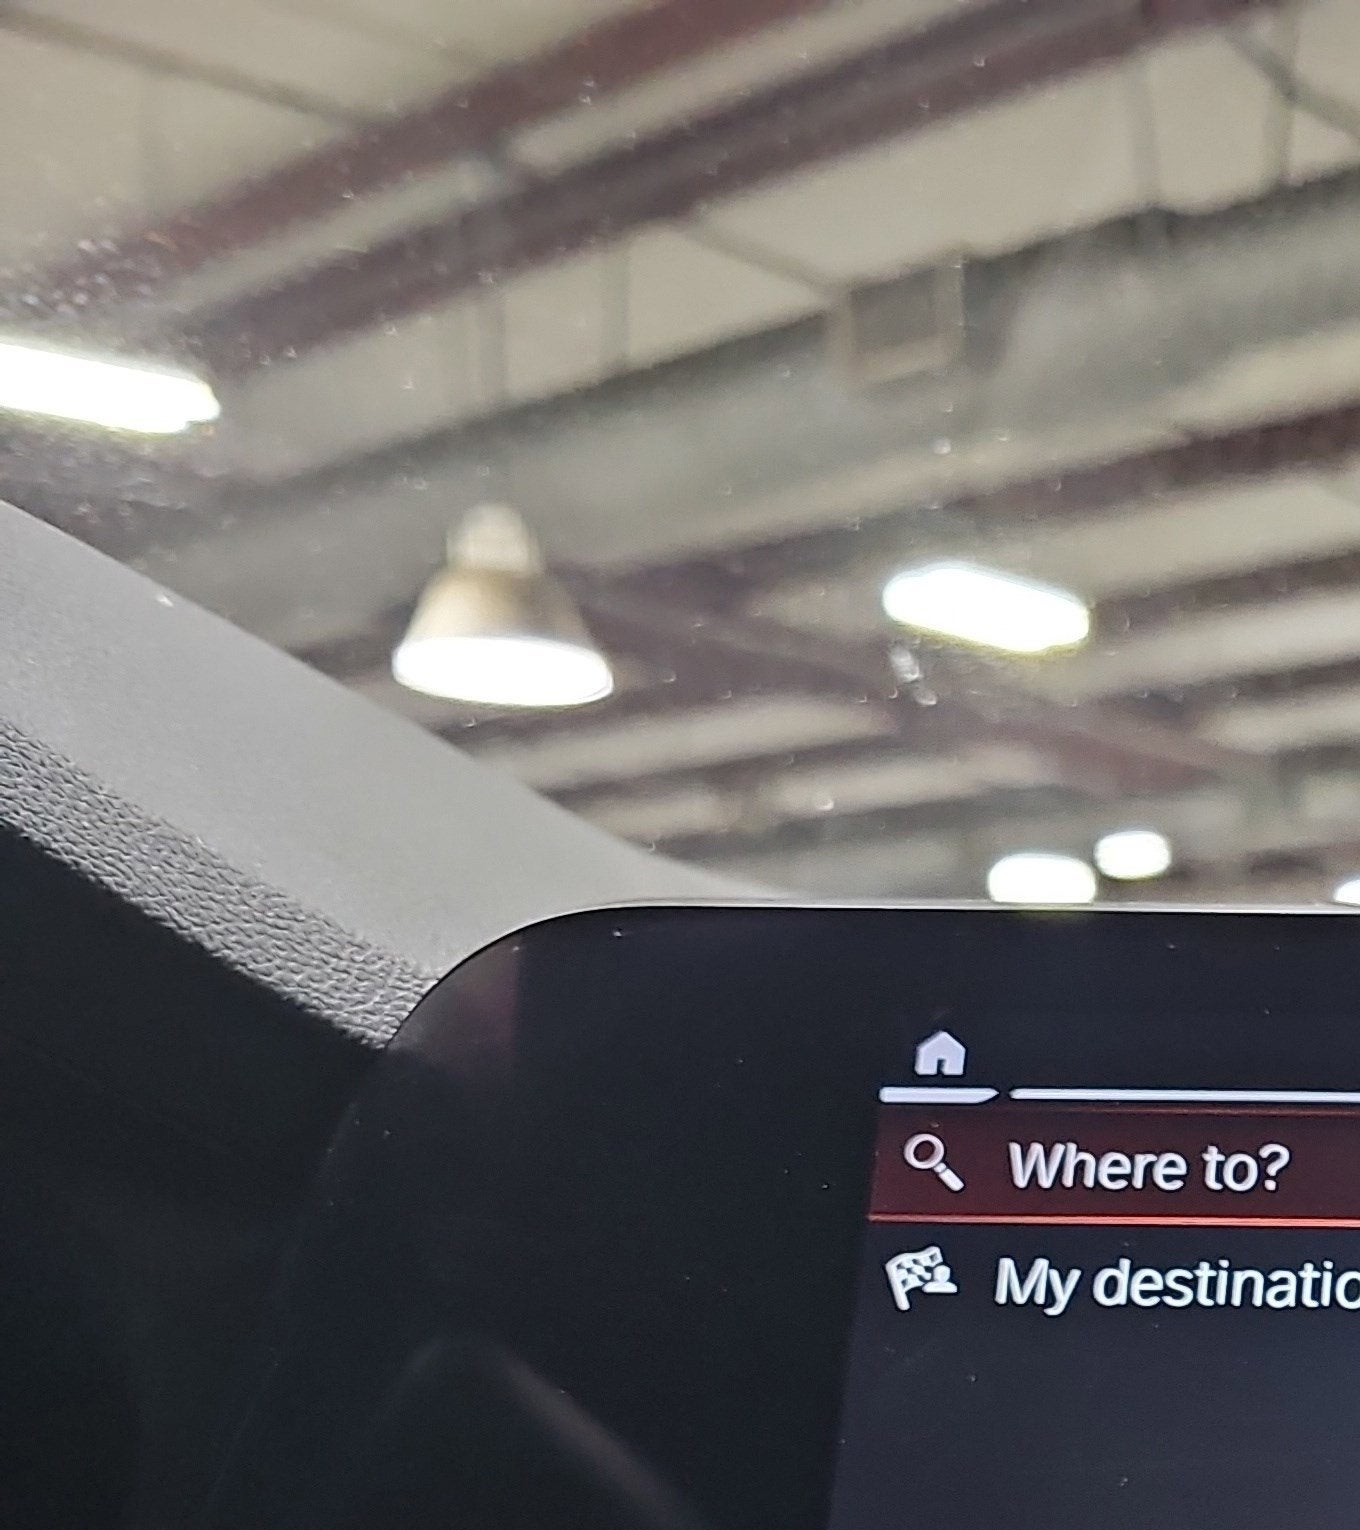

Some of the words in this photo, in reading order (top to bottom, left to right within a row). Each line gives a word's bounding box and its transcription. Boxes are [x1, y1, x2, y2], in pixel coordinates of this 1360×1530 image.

[1009, 1142, 1187, 1192] Where
[1204, 1143, 1289, 1192] to?
[994, 1258, 1079, 1315] My
